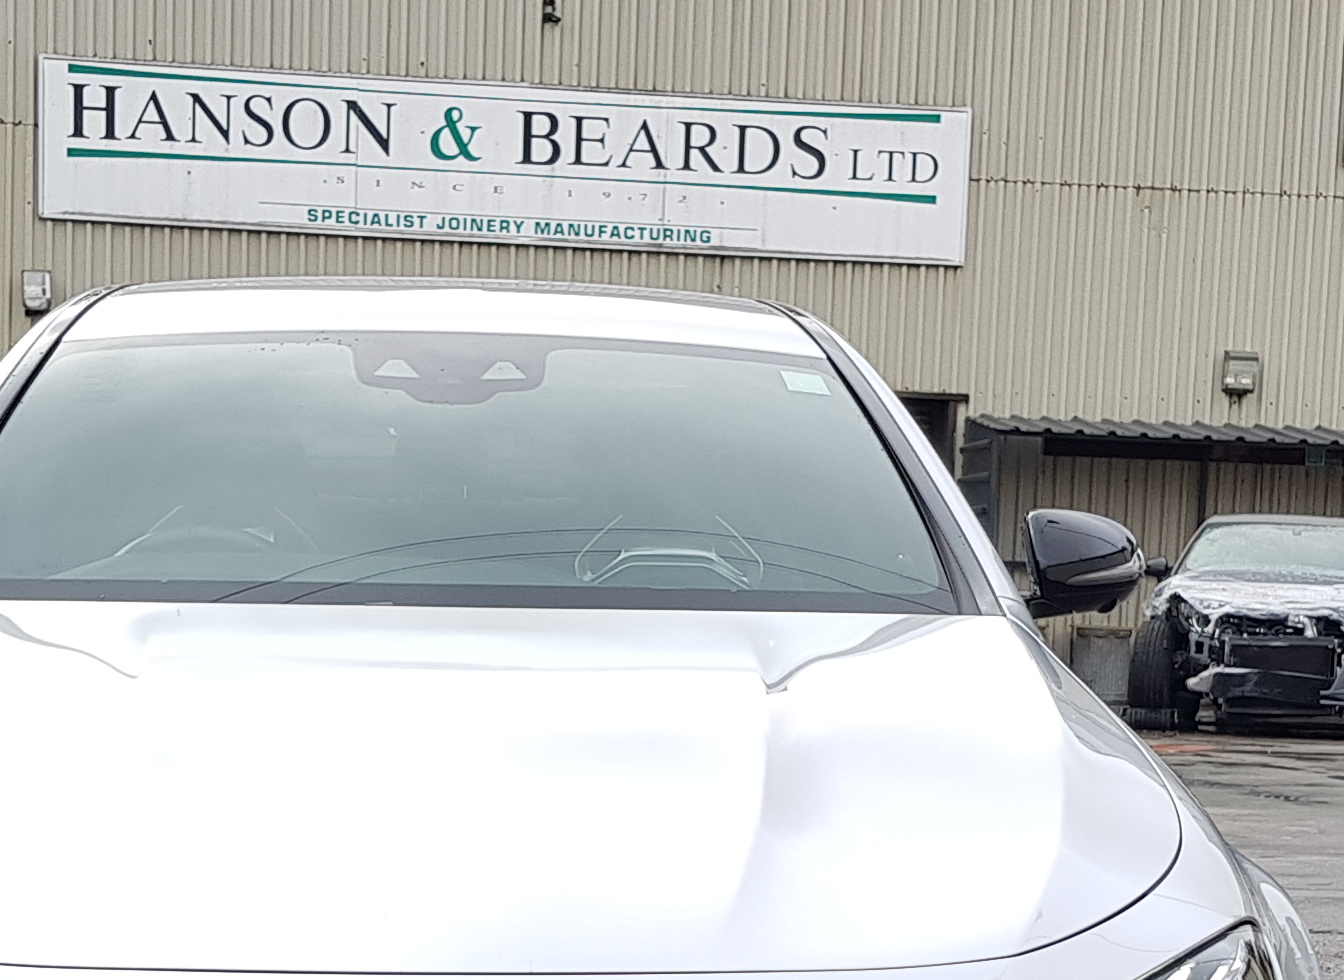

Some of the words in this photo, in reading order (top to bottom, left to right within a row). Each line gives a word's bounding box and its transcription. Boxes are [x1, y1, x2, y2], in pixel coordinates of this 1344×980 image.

[67, 82, 398, 157] HANSON
[430, 105, 484, 162] &
[515, 109, 830, 181] BEARDS
[847, 147, 939, 184] LTD
[307, 208, 428, 230] SPECIALIST
[435, 216, 525, 235] JOINERY
[534, 221, 713, 244] MANUFACTURING
